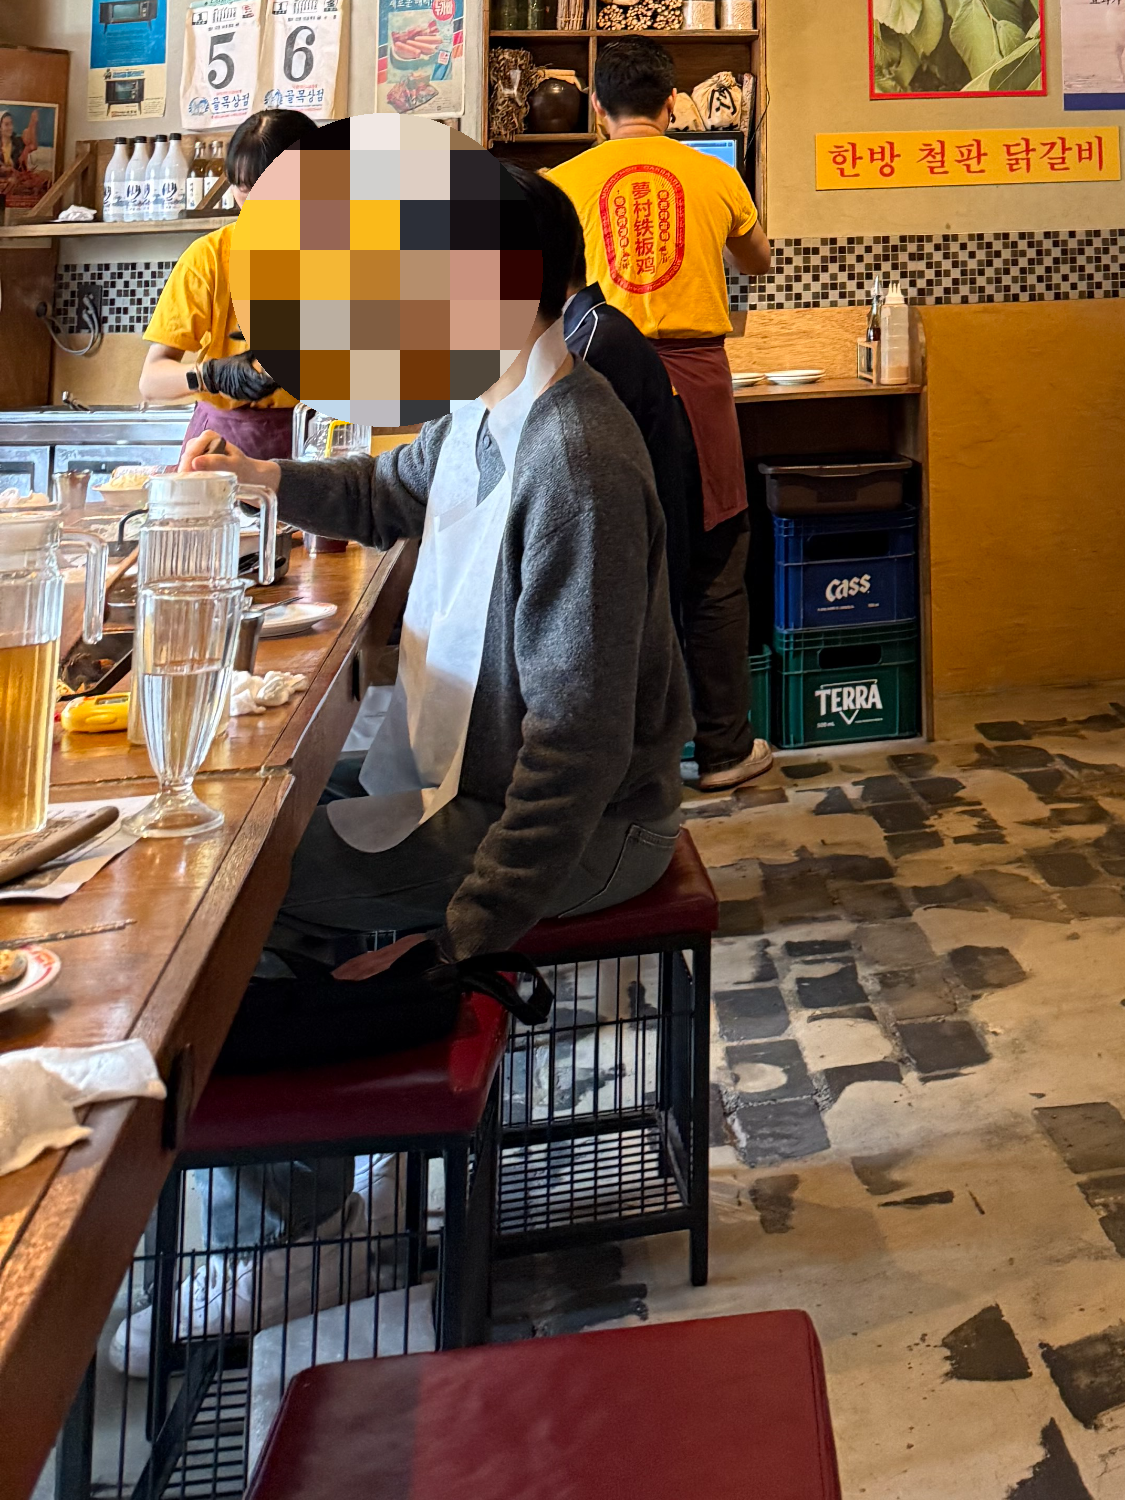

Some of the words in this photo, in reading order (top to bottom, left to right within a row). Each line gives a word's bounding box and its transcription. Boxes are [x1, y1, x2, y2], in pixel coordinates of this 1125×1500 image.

[207, 31, 236, 90] 5
[283, 25, 316, 82] 6
[211, 92, 250, 111] 골목상점
[285, 88, 324, 103] 골목상점
[828, 140, 900, 179] 한방
[916, 139, 989, 175] 철판
[1003, 135, 1104, 174] 닭갈비
[825, 573, 871, 603] Cass
[814, 683, 883, 716] TERRA
